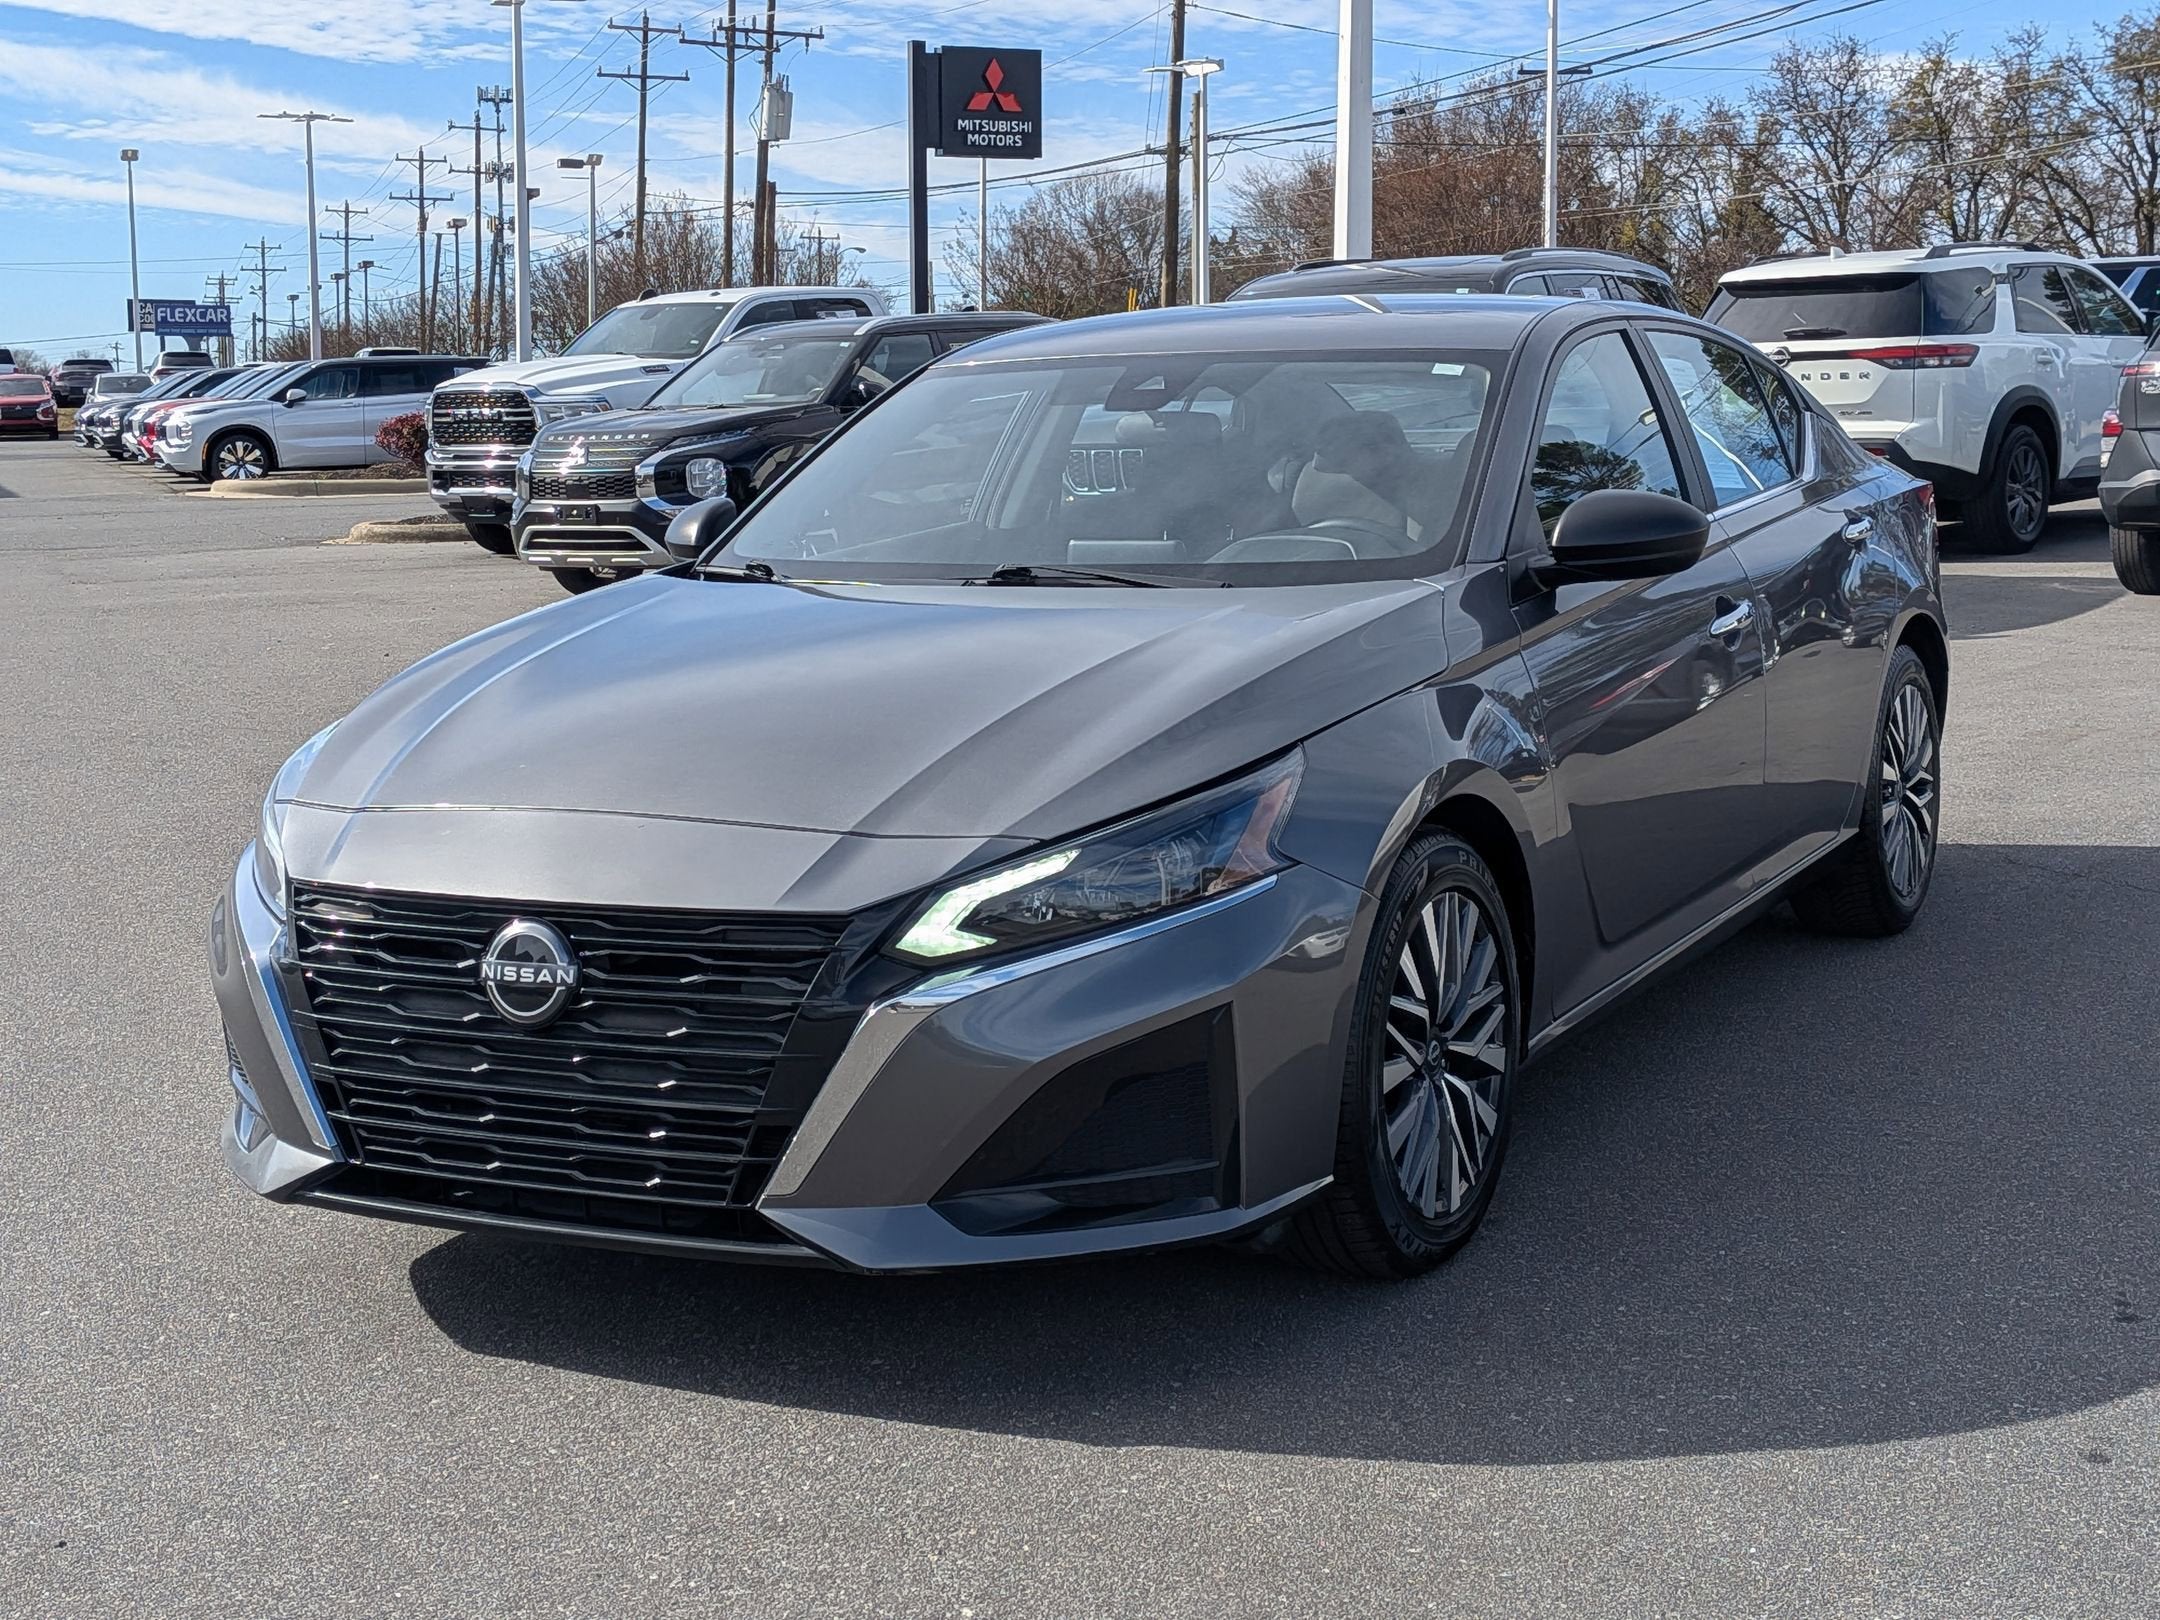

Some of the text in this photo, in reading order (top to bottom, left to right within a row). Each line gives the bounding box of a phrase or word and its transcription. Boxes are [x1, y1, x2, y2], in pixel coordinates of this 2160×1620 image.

[957, 119, 1032, 133] MITSUBISHI
[967, 133, 1023, 147] MOTORS
[157, 307, 228, 322] FLEXCAR
[482, 963, 574, 984] NISSAN
